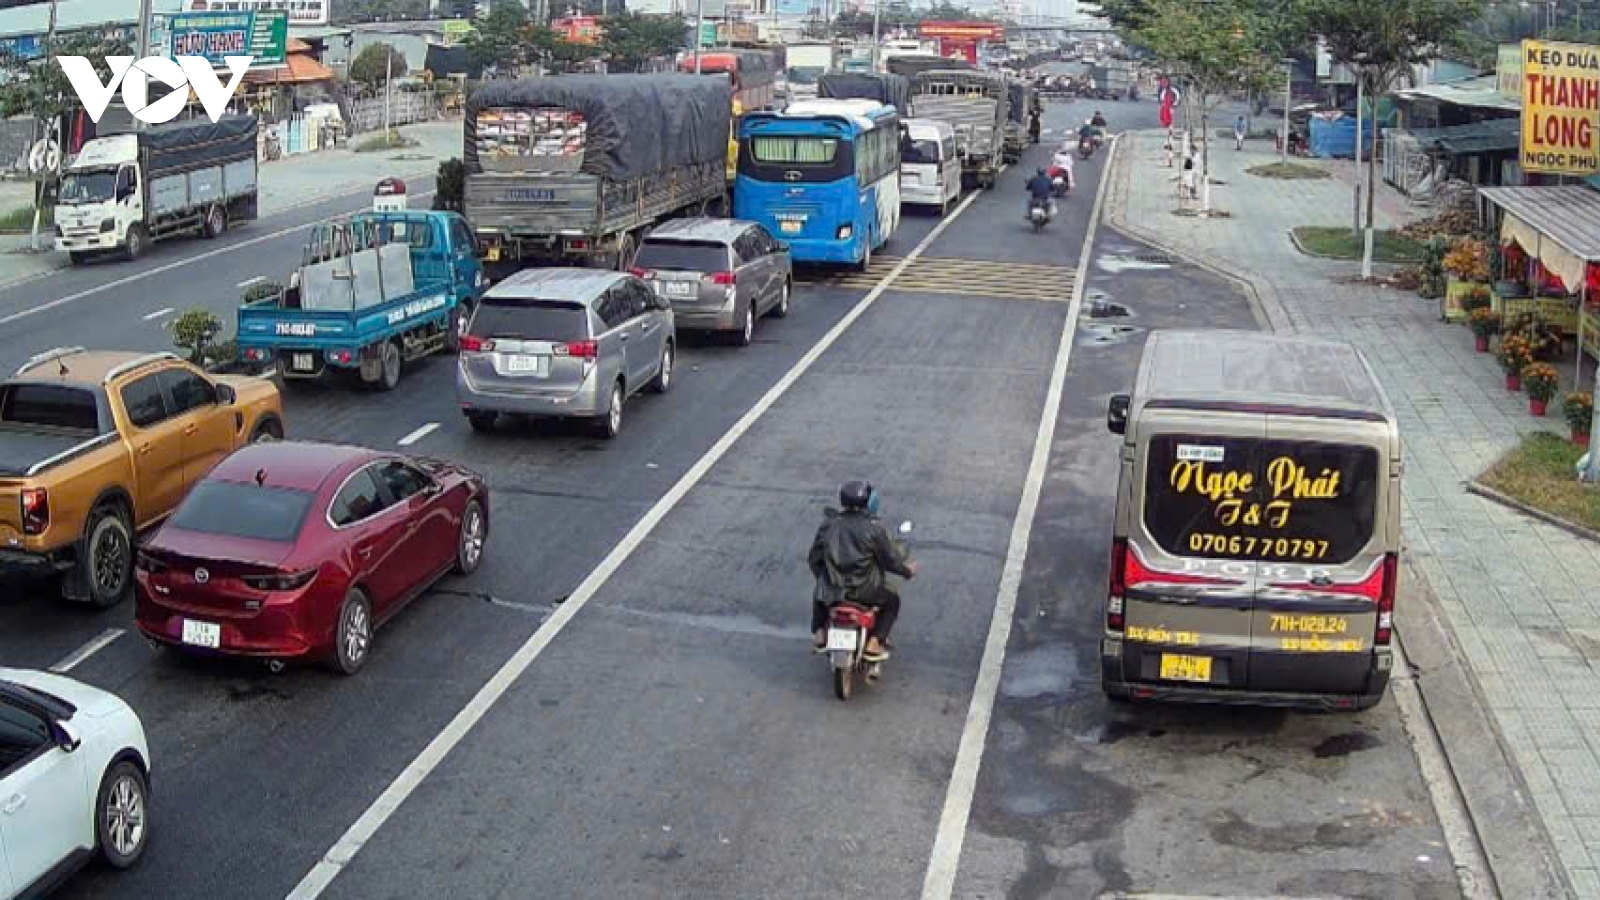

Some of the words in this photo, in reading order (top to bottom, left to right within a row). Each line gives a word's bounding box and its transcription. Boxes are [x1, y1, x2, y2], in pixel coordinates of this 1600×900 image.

[1526, 73, 1599, 109] THANH
[1533, 113, 1591, 149] LONG
[1191, 534, 1329, 557] 0706770797
